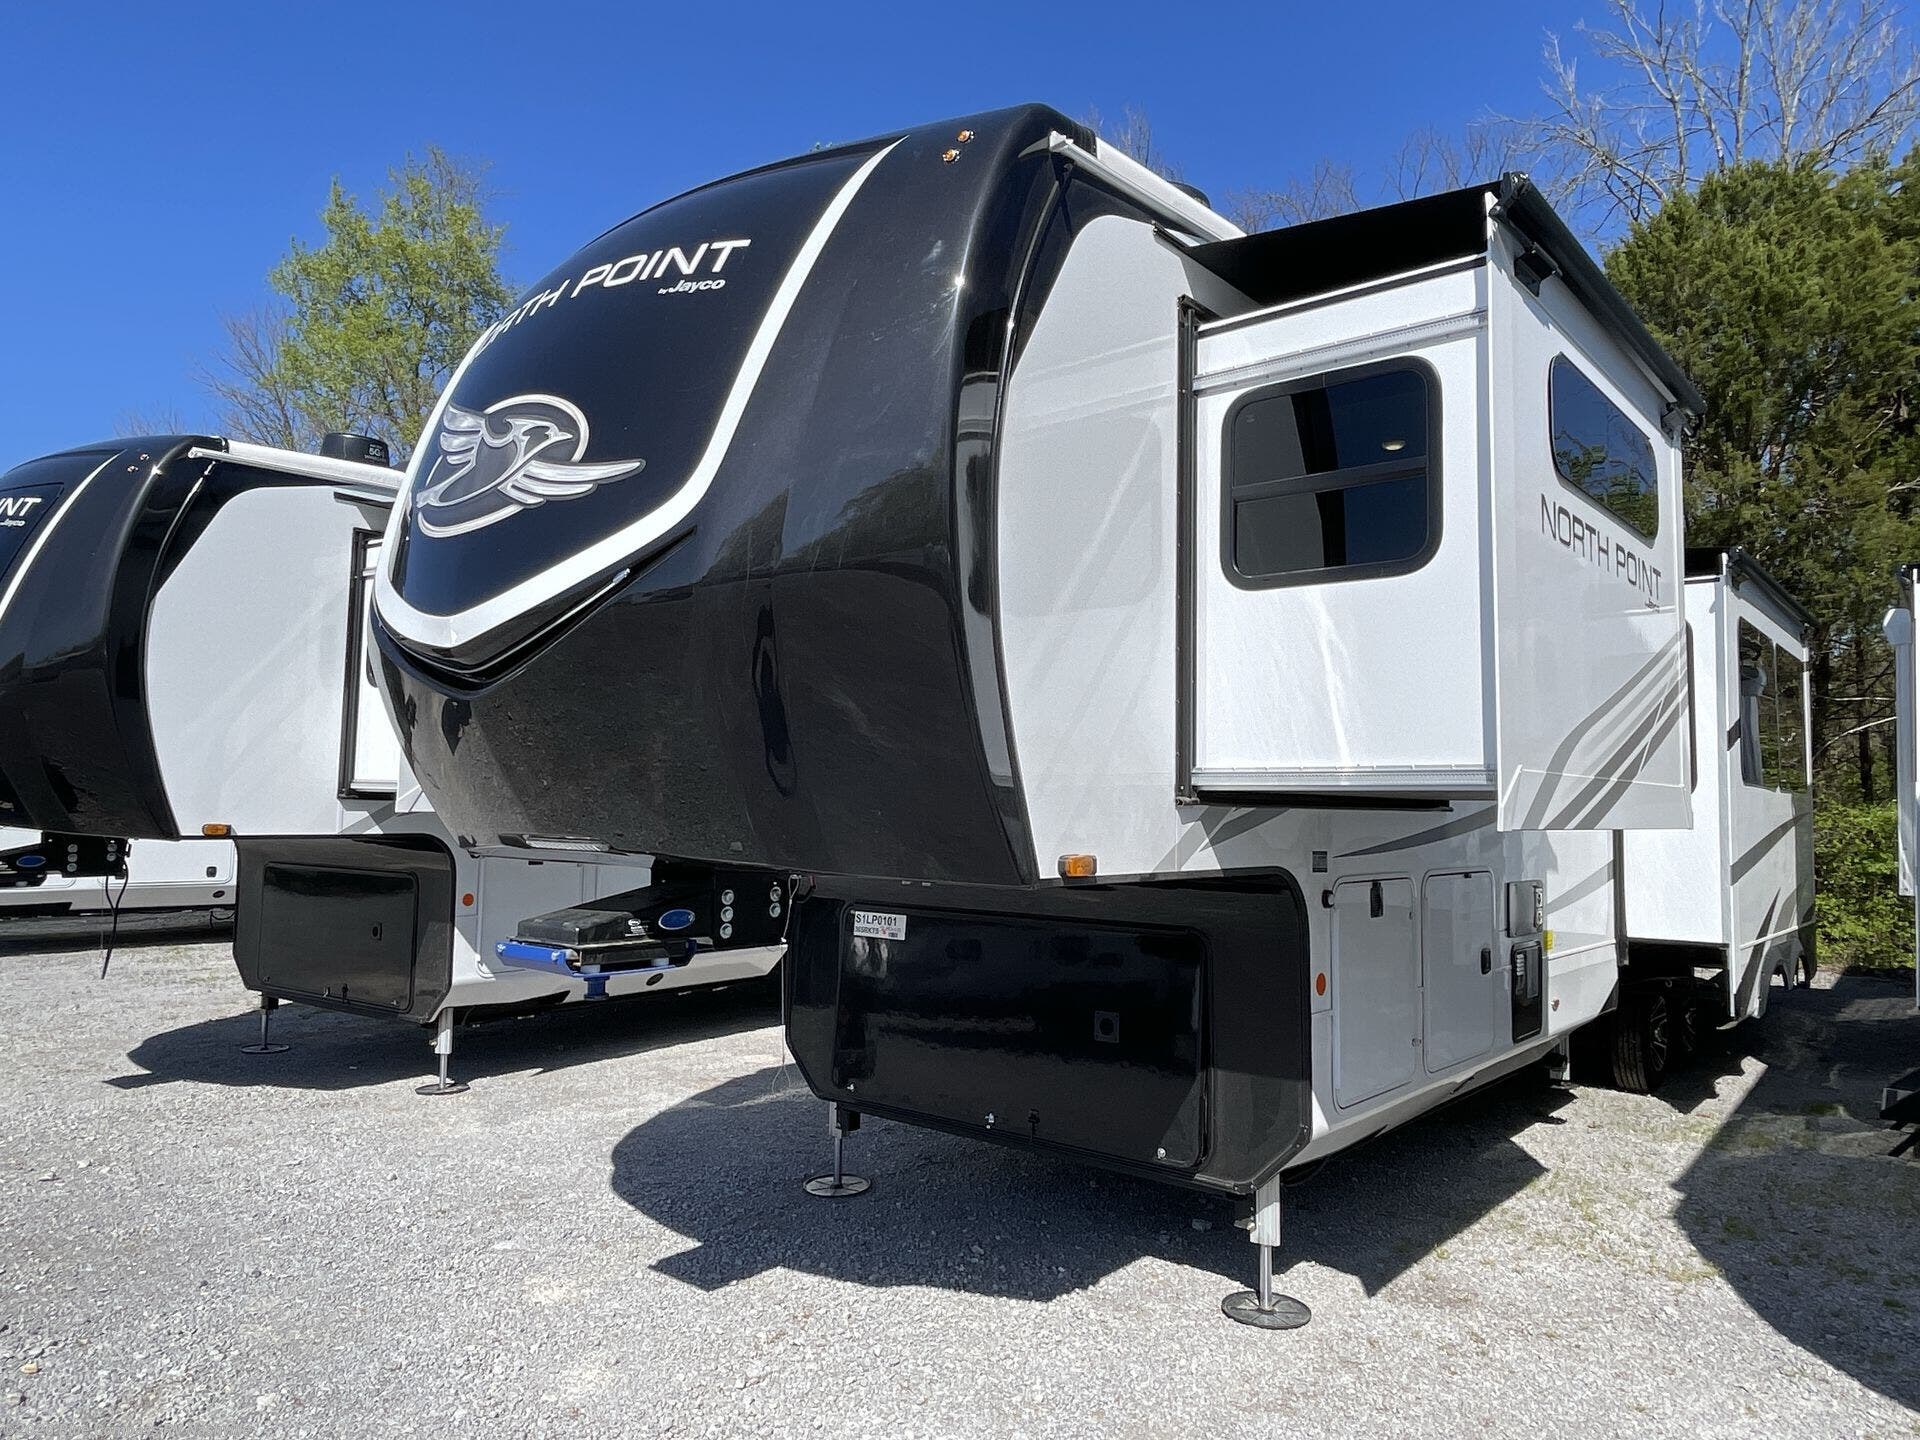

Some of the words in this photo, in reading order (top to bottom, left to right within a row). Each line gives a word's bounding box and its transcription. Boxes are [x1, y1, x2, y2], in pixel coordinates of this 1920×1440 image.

[474, 279, 571, 359] ORTH
[570, 239, 752, 299] POINT
[668, 279, 726, 294] Jayco
[1541, 493, 1610, 572] NORTH
[1616, 542, 1662, 601] POINT
[855, 913, 897, 926] S1LP0101
